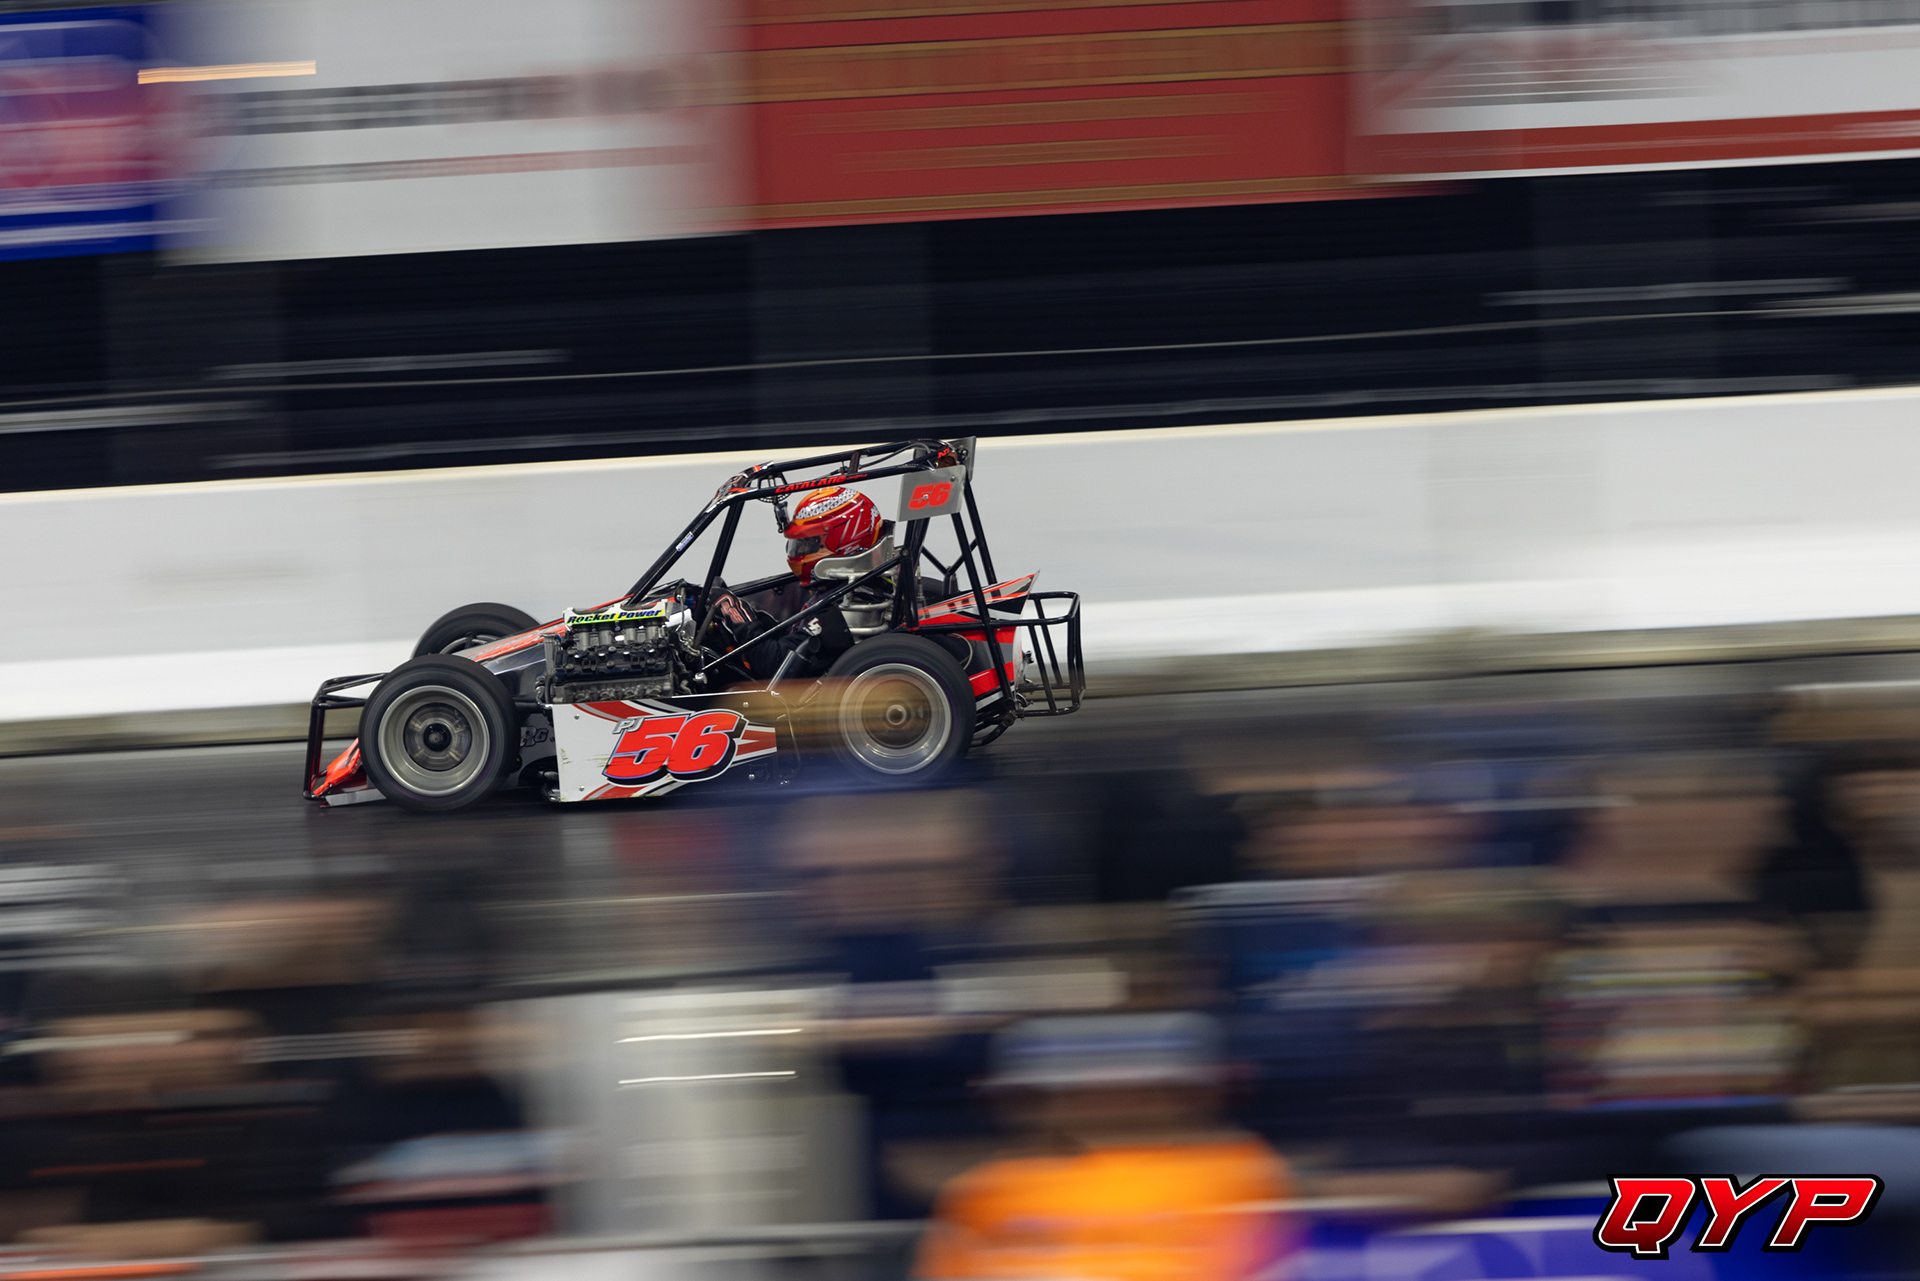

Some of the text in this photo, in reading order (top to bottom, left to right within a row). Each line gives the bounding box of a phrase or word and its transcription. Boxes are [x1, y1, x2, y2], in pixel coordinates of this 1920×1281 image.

[907, 481, 953, 510] 56
[567, 609, 663, 624] Rocket Power
[612, 716, 645, 734] PJ
[603, 711, 741, 780] 56
